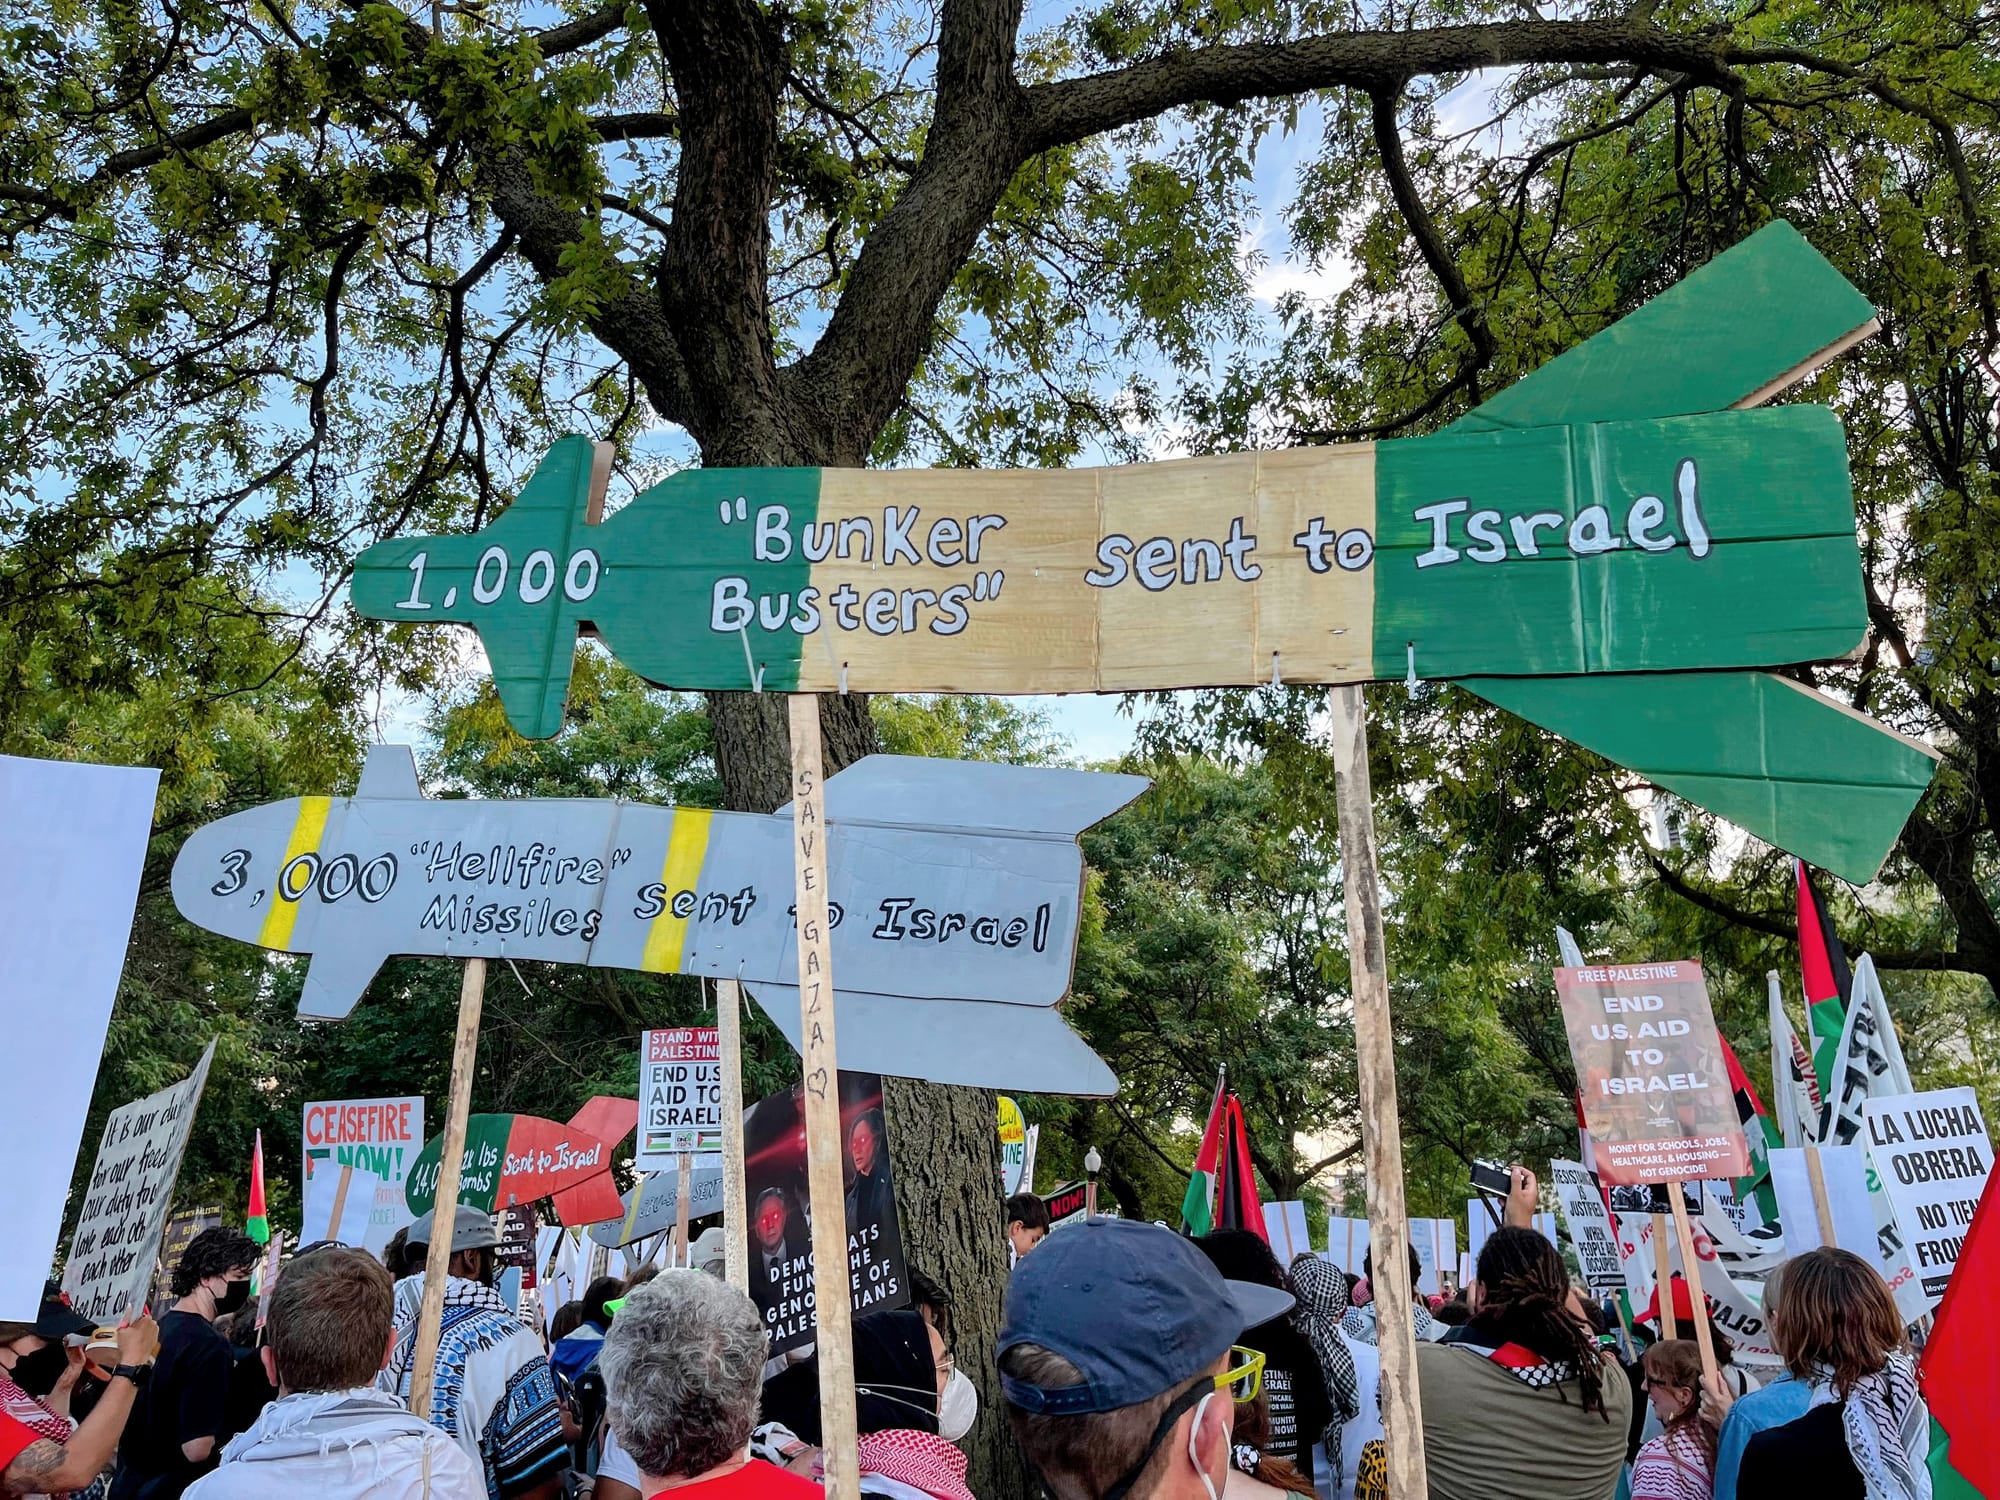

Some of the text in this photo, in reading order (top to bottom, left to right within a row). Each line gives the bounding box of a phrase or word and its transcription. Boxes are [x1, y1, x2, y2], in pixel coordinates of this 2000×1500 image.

[1084, 457, 1714, 593] sent to Israel
[394, 545, 600, 610] 1,000
[710, 569, 1005, 636] Busters"
[410, 839, 632, 890] "Hellfire"
[211, 848, 398, 908] 3,000
[420, 894, 603, 943] Missiles
[797, 770, 826, 1051] SAVE GAZA
[787, 901, 845, 930] o
[871, 897, 1052, 953] Israel
[1577, 965, 1679, 983] FREE PALESTINE
[1603, 994, 1664, 1014] END
[652, 1031, 720, 1044] STAND WIT
[1591, 1019, 1691, 1040] U.S. AID
[1625, 1048, 1664, 1066] TO
[652, 1066, 720, 1083] END U.S
[1600, 1072, 1709, 1095] ISRAEL
[649, 1085, 687, 1106] AID
[119, 1115, 132, 1143] is
[133, 1110, 159, 1138] our
[306, 1103, 412, 1145] CEASEFIRE
[1867, 1105, 1983, 1146] LA LUCHA
[478, 1140, 498, 1167] lbs
[1608, 1137, 1731, 1154] MONEY FOR SCHOOLS, JOBS,
[110, 1155, 136, 1184] our
[337, 1144, 404, 1181] NOW!
[537, 1150, 552, 1174] to
[1612, 1154, 1667, 1166] HEALTHCARE,
[1676, 1150, 1719, 1162] HOUSING
[1891, 1146, 1986, 1185] OBRERA
[1639, 1164, 1708, 1178] NOT GENOCIDE!
[1051, 1188, 1084, 1218] NOW!
[1576, 1185, 1587, 1201] IS
[81, 1194, 107, 1223] our
[489, 1212, 517, 1223] ED
[1569, 1201, 1604, 1217] JUSTIFIED
[1916, 1199, 1980, 1230] NO TIEN
[75, 1229, 96, 1259] love
[101, 1217, 125, 1249] each
[1583, 1226, 1607, 1241] WHEN
[850, 1247, 872, 1271] HE
[1578, 1241, 1606, 1257] PEOPLE
[1606, 1242, 1618, 1256] ARE
[81, 1252, 107, 1286] each
[868, 1259, 891, 1282] OF
[1264, 1380, 1291, 1390] SRAEL
[1275, 1424, 1297, 1435] NOW!
